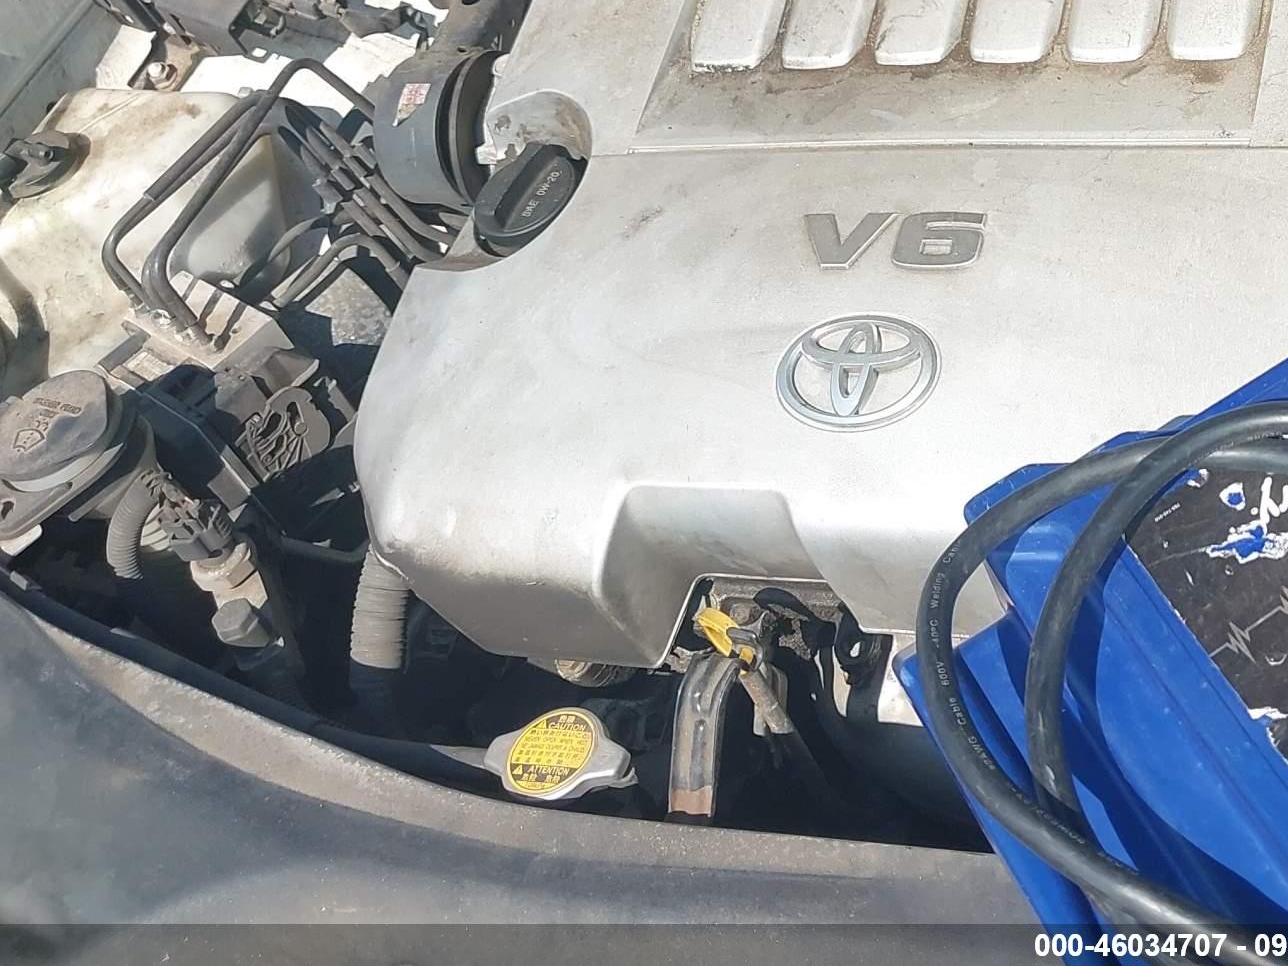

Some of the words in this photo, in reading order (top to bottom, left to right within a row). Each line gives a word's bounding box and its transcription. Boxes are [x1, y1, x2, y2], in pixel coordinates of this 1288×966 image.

[803, 211, 988, 270] V6
[548, 721, 586, 732] CAUTION
[527, 766, 569, 776] ATTENTION
